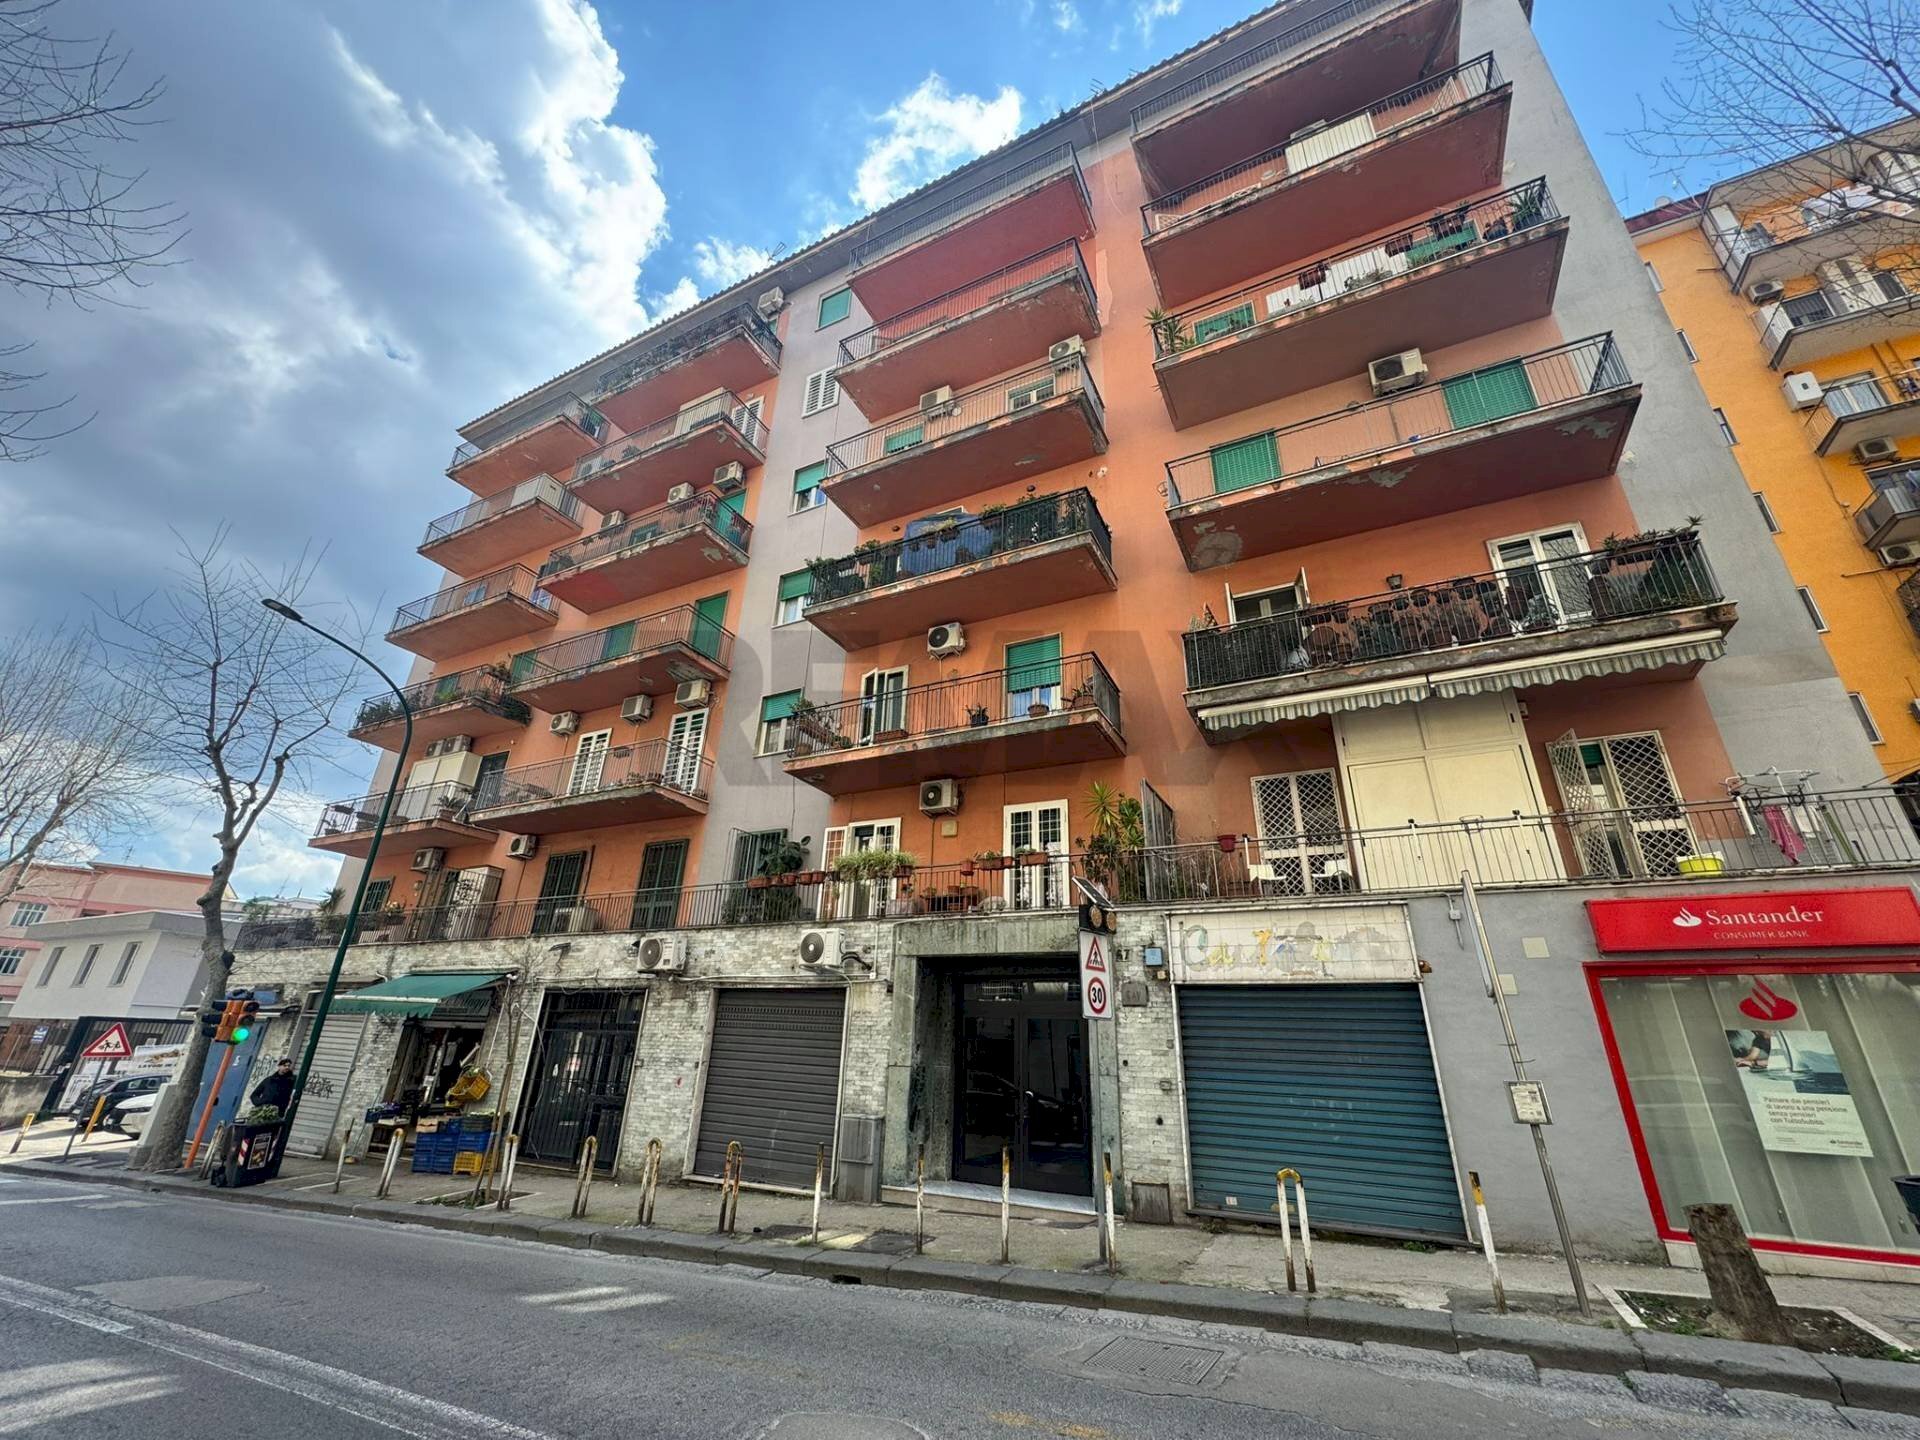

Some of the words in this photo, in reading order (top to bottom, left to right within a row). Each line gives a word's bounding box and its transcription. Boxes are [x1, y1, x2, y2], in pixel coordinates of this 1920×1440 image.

[1705, 905, 1823, 926] Santander
[1713, 931, 1775, 941] CONSUMER
[1779, 930, 1808, 938] BANK
[1092, 987, 1103, 1004] 30
